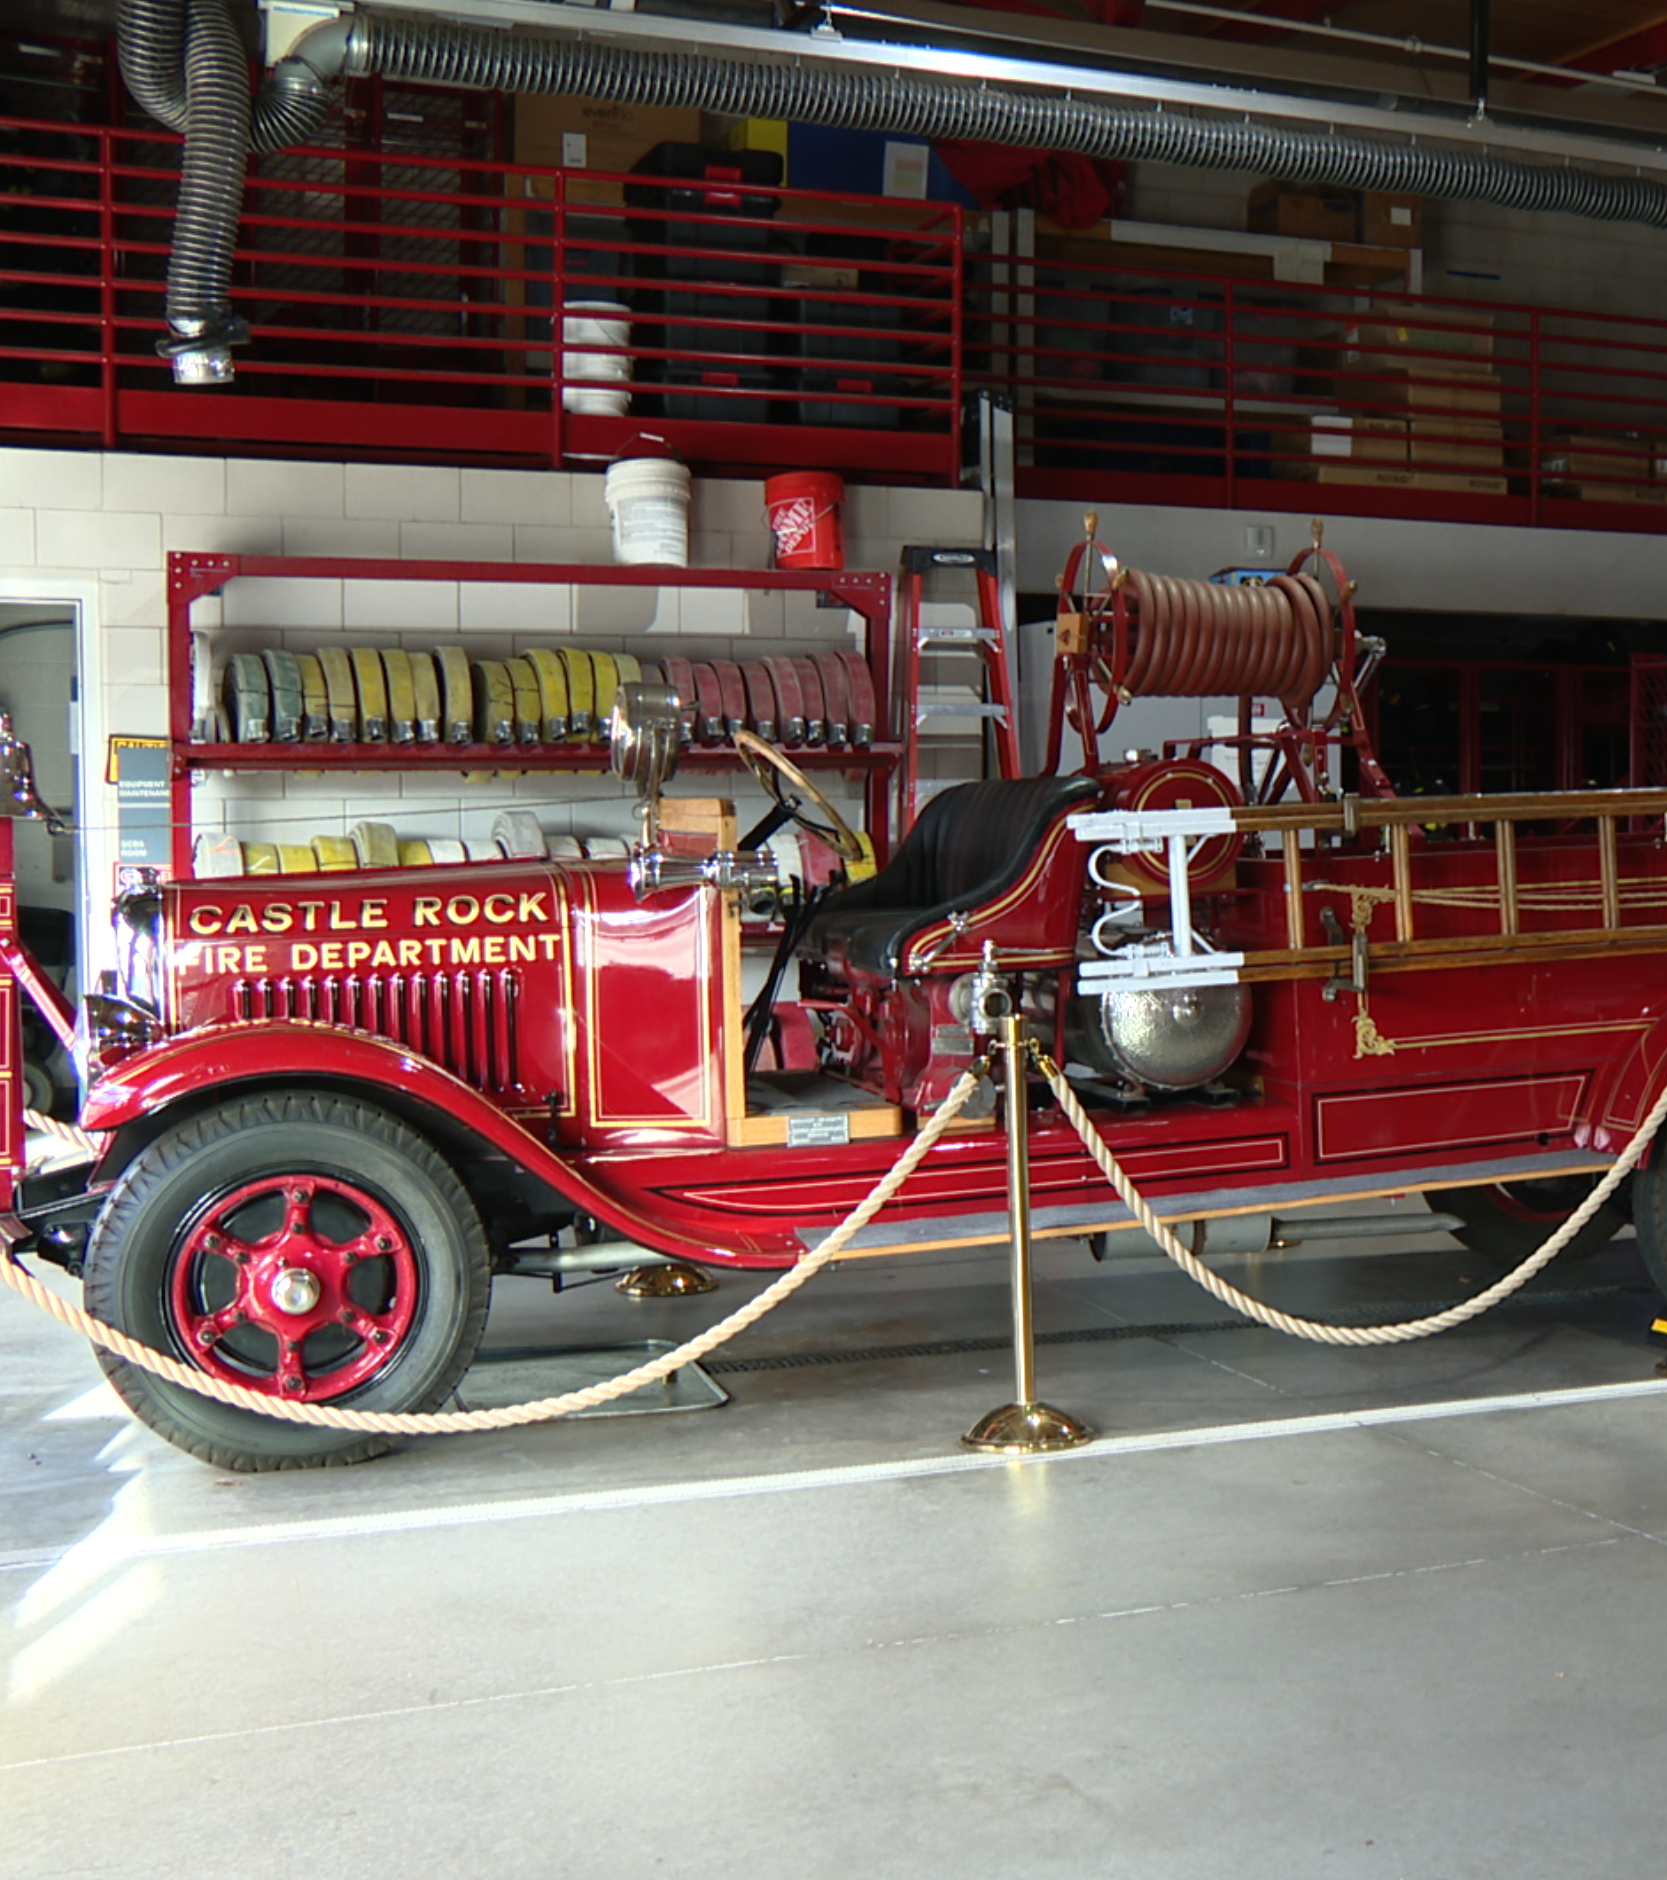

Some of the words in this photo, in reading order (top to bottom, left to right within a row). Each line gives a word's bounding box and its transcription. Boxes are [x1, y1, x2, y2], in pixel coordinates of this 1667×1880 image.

[189, 899, 388, 935] CASTLE
[414, 893, 549, 927] ROCK
[291, 934, 561, 971] DEPARTMENT
